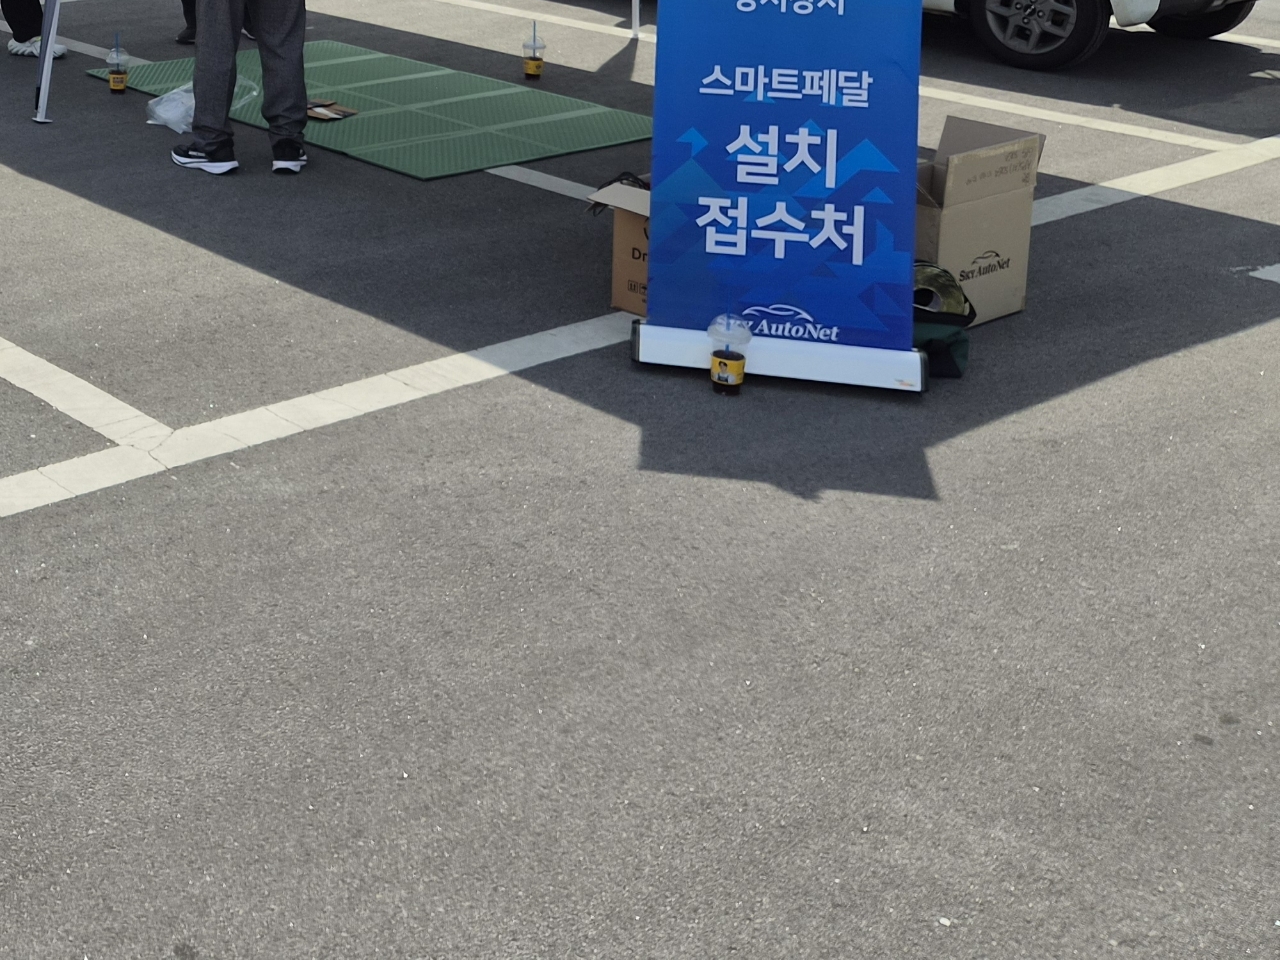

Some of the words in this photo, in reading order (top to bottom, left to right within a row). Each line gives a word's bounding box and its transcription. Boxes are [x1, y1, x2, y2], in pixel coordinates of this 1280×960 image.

[699, 65, 873, 107] 스마트페달
[725, 125, 837, 189] 설치
[695, 196, 865, 266] 접수처
[753, 319, 840, 341] AutoNet
